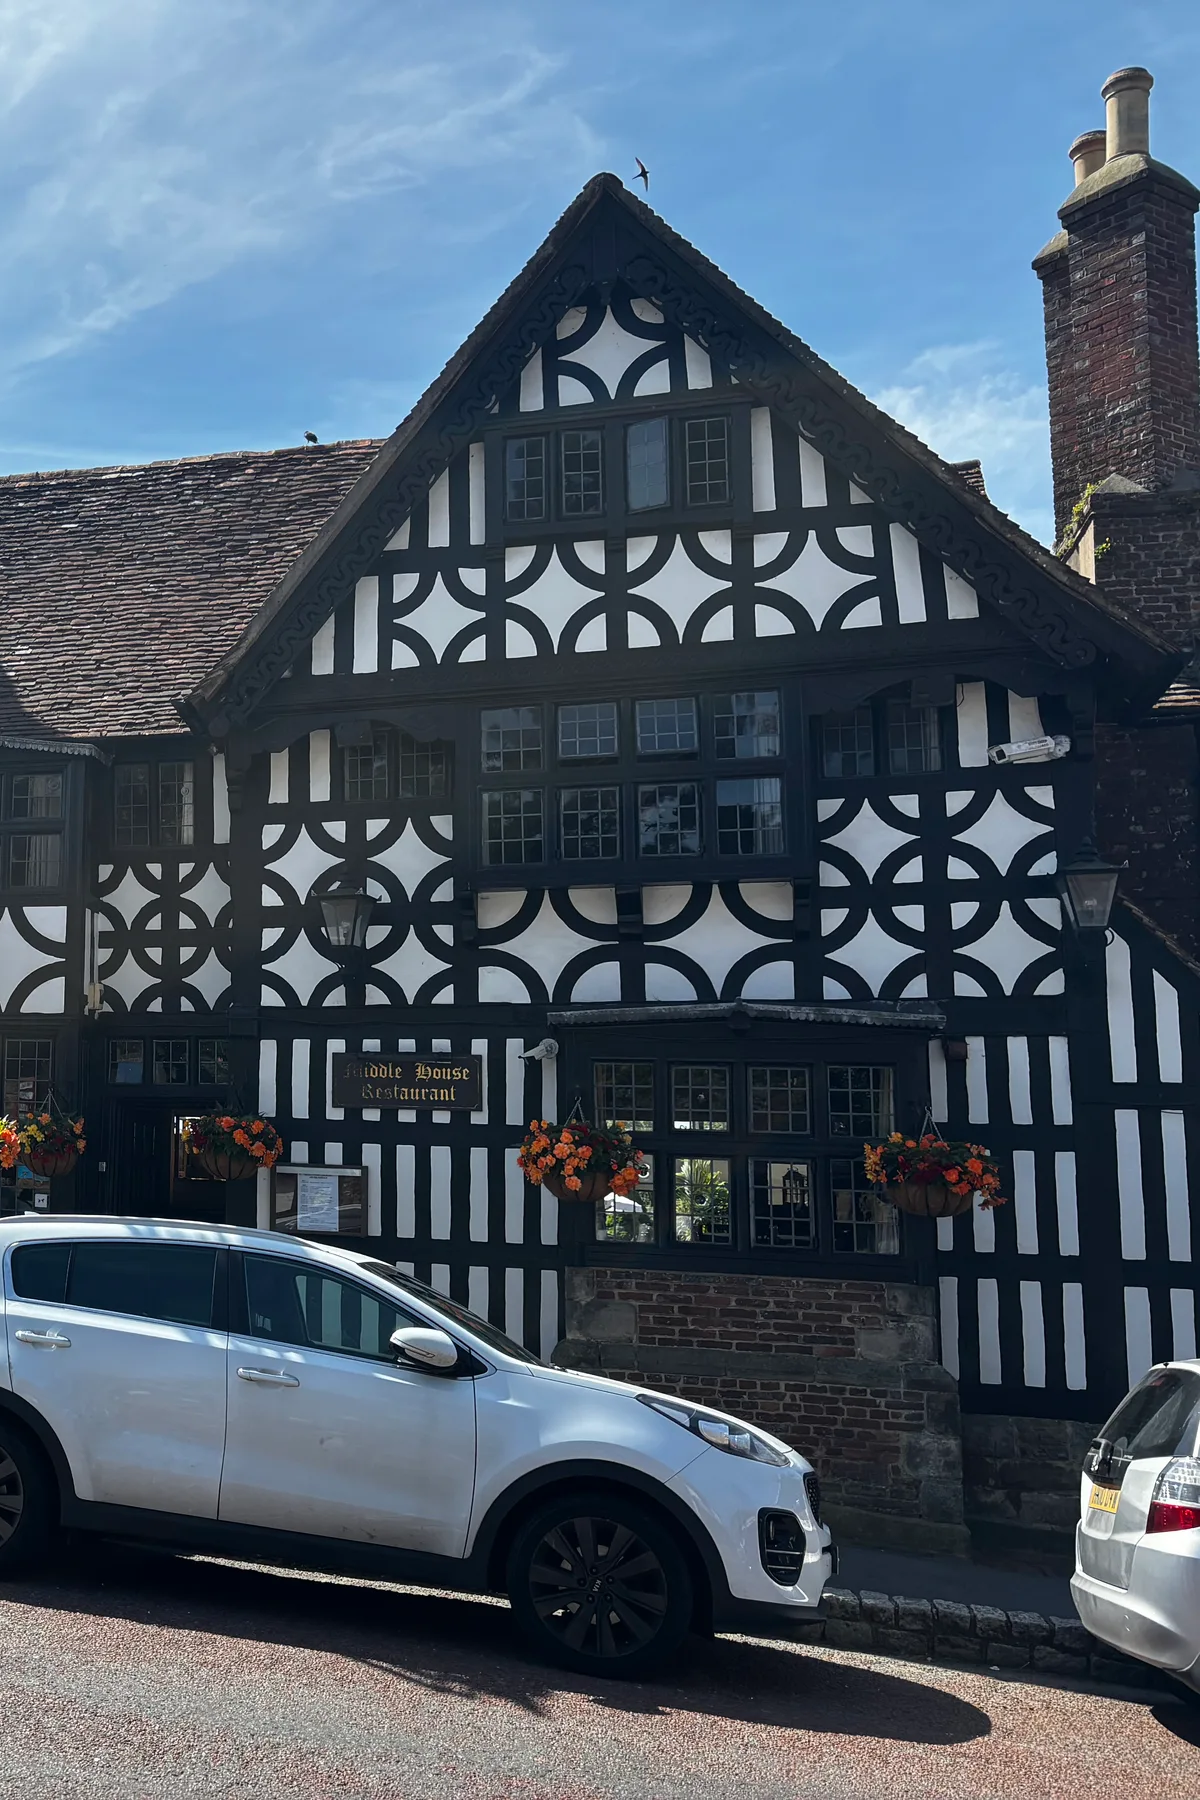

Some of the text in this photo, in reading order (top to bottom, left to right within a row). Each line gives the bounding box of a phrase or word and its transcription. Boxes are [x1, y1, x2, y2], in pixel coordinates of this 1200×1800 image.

[414, 1062, 471, 1082] House
[361, 1083, 456, 1102] Restaurant
[592, 1579, 602, 1592] KIA
